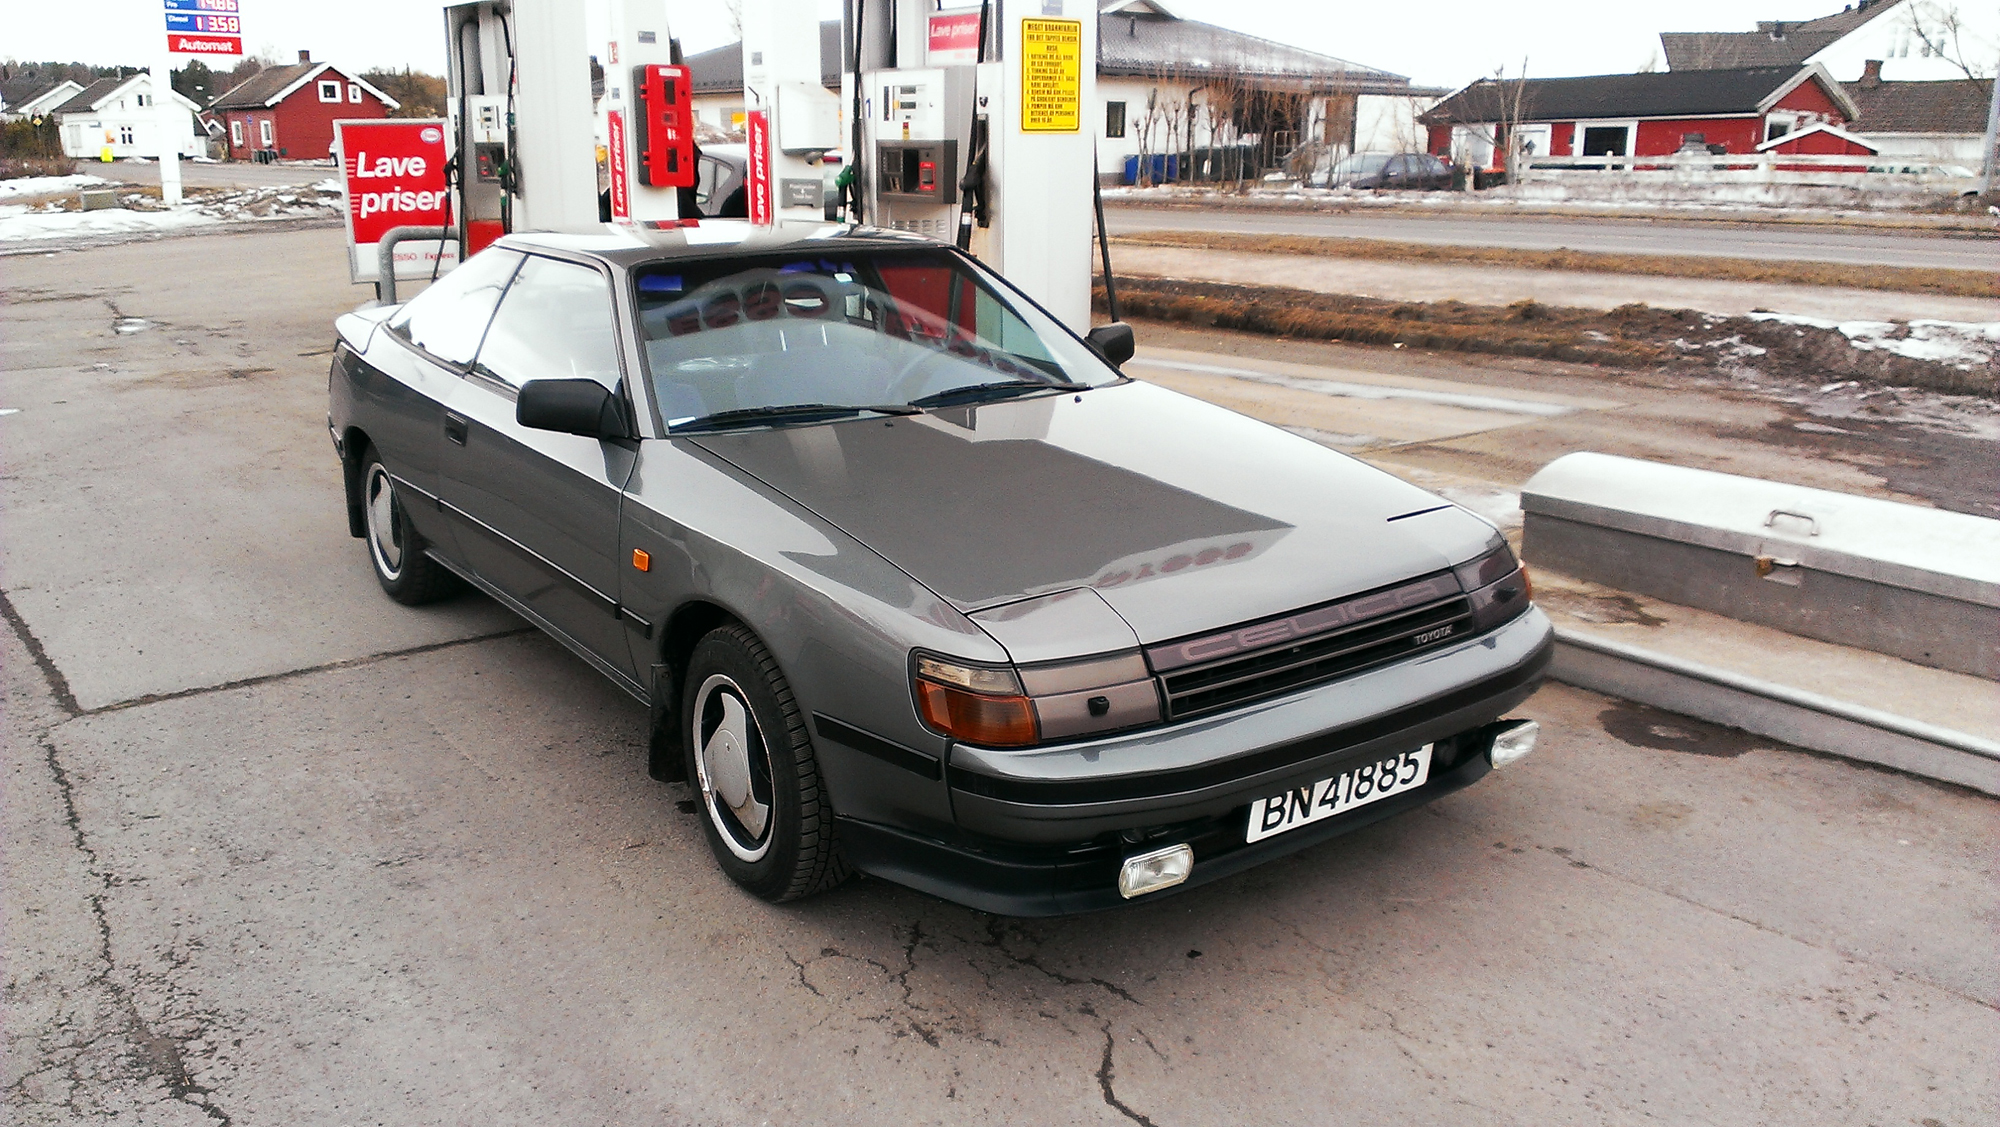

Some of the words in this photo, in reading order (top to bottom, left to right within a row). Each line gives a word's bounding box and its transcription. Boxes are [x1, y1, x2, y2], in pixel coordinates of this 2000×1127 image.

[931, 24, 951, 37] Lave
[951, 22, 977, 38] priser
[178, 38, 234, 52] Automat
[866, 98, 871, 118] 1
[613, 122, 623, 171] priser
[754, 122, 766, 180] priser
[357, 151, 427, 178] Lave
[360, 186, 446, 219] priser
[616, 174, 624, 213] Lave
[1414, 624, 1452, 645] TOYOTA
